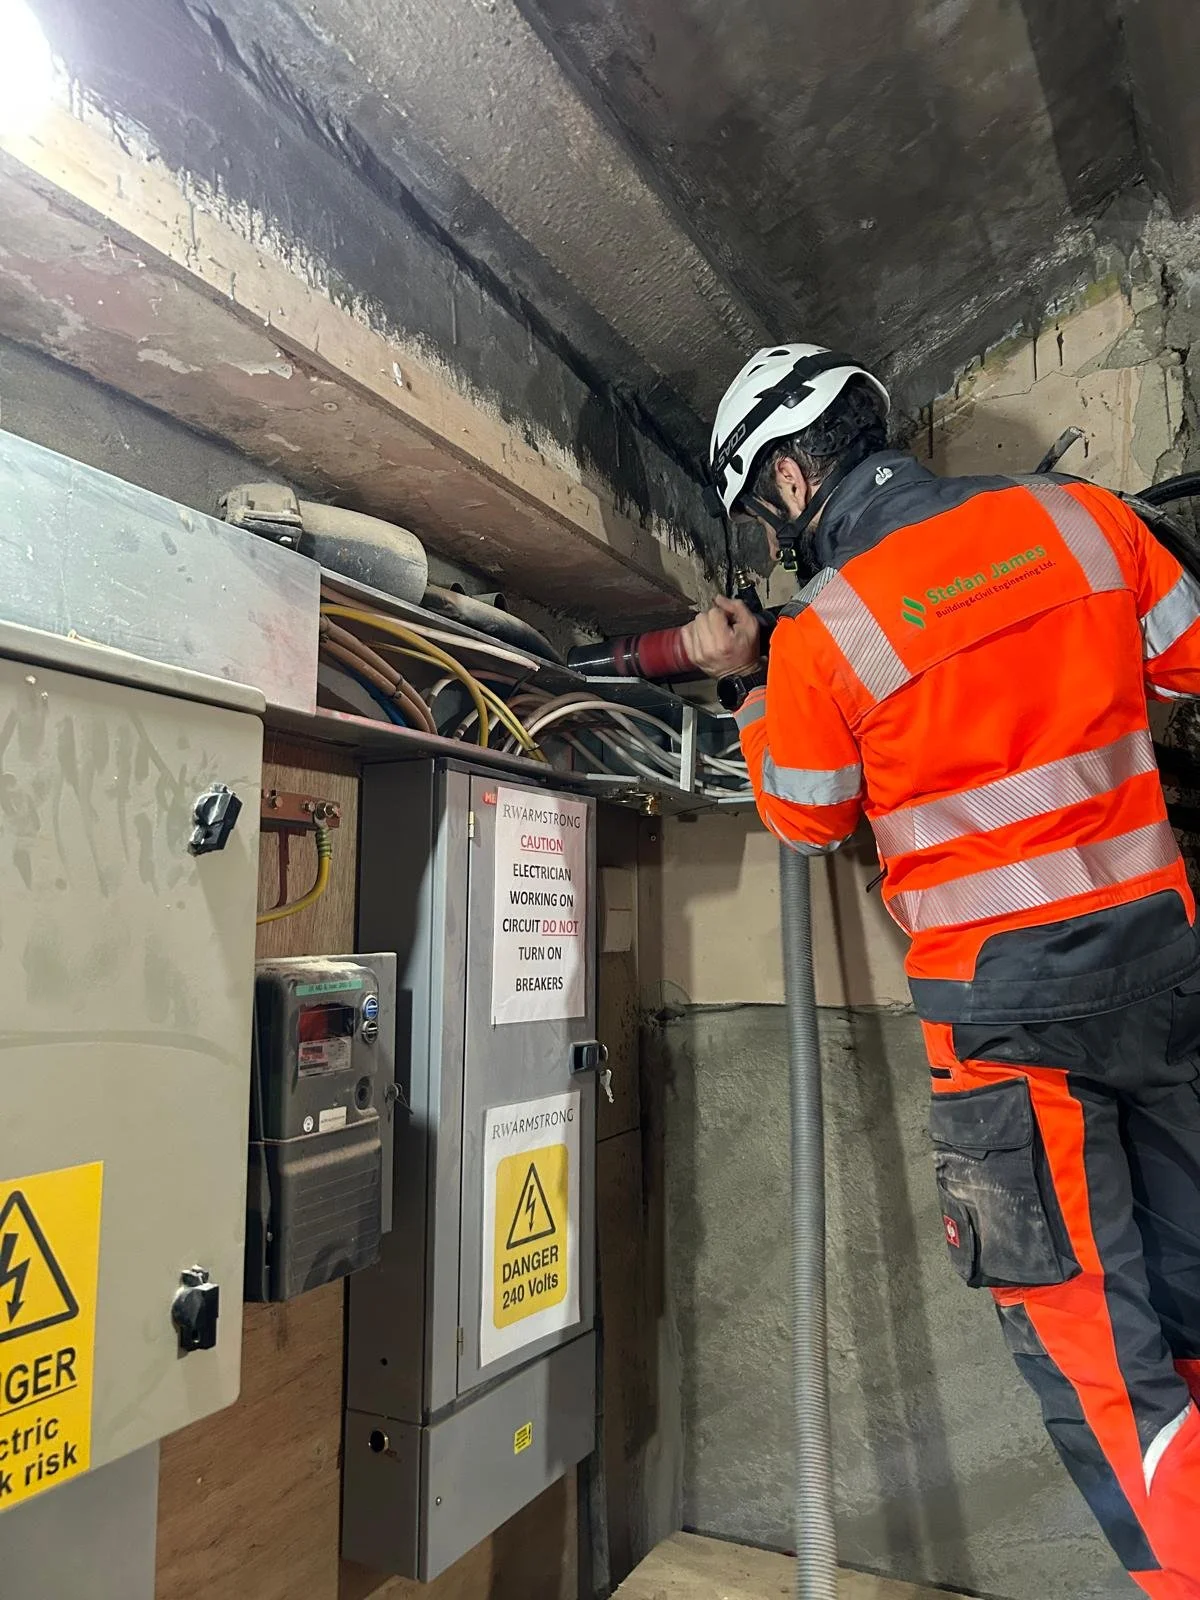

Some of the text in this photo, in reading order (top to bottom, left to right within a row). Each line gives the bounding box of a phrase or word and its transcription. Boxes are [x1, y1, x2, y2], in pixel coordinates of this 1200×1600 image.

[926, 545, 1046, 604] Stefan James
[993, 567, 1041, 593] Engineering
[1039, 560, 1057, 572] Ltd.
[503, 804, 580, 828] RWARMSTRONG
[520, 835, 563, 852] CAUTION
[513, 863, 571, 881] ELECTRICIAN
[510, 890, 574, 907] WORKING ON
[502, 918, 579, 934] CIRCUIT DO NOT
[518, 946, 562, 960] TURN ON
[516, 976, 563, 992] BREAKERS
[492, 1108, 574, 1139] RWARMSTRONG
[502, 1245, 559, 1283] DANGER
[502, 1273, 559, 1310] 240 Volts
[0, 1347, 77, 1405] GER
[24, 1441, 78, 1487] risk
